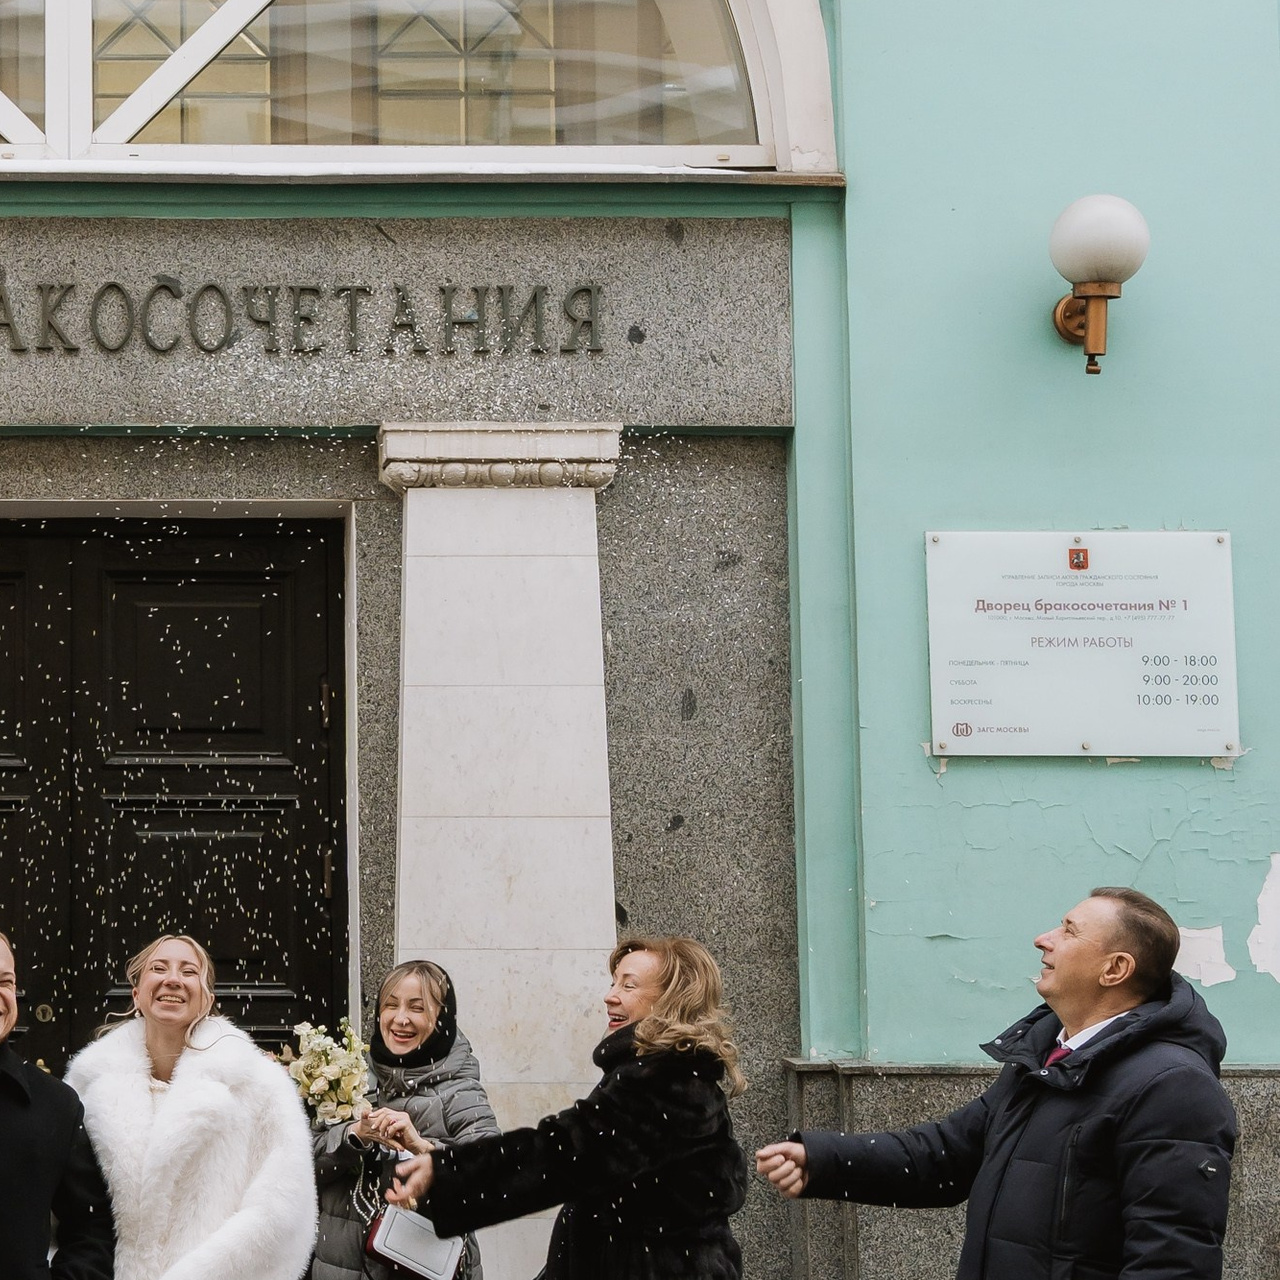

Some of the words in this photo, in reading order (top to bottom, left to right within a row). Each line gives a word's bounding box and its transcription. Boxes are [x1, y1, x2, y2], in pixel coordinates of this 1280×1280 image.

[974, 599, 1031, 614] Дворец
[1034, 599, 1154, 614] бракосочетания
[1158, 599, 1177, 611] №
[1182, 599, 1188, 611] 1
[1030, 636, 1079, 648] РЕЖИМ
[1083, 636, 1133, 648] РАБОТЫ
[1141, 655, 1171, 667] 9:00
[1184, 655, 1218, 667] 18:00
[1142, 674, 1171, 686] 9:00
[1182, 674, 1219, 686] 20:00
[1136, 694, 1172, 706] 10:00
[1185, 694, 1219, 706] 19:00
